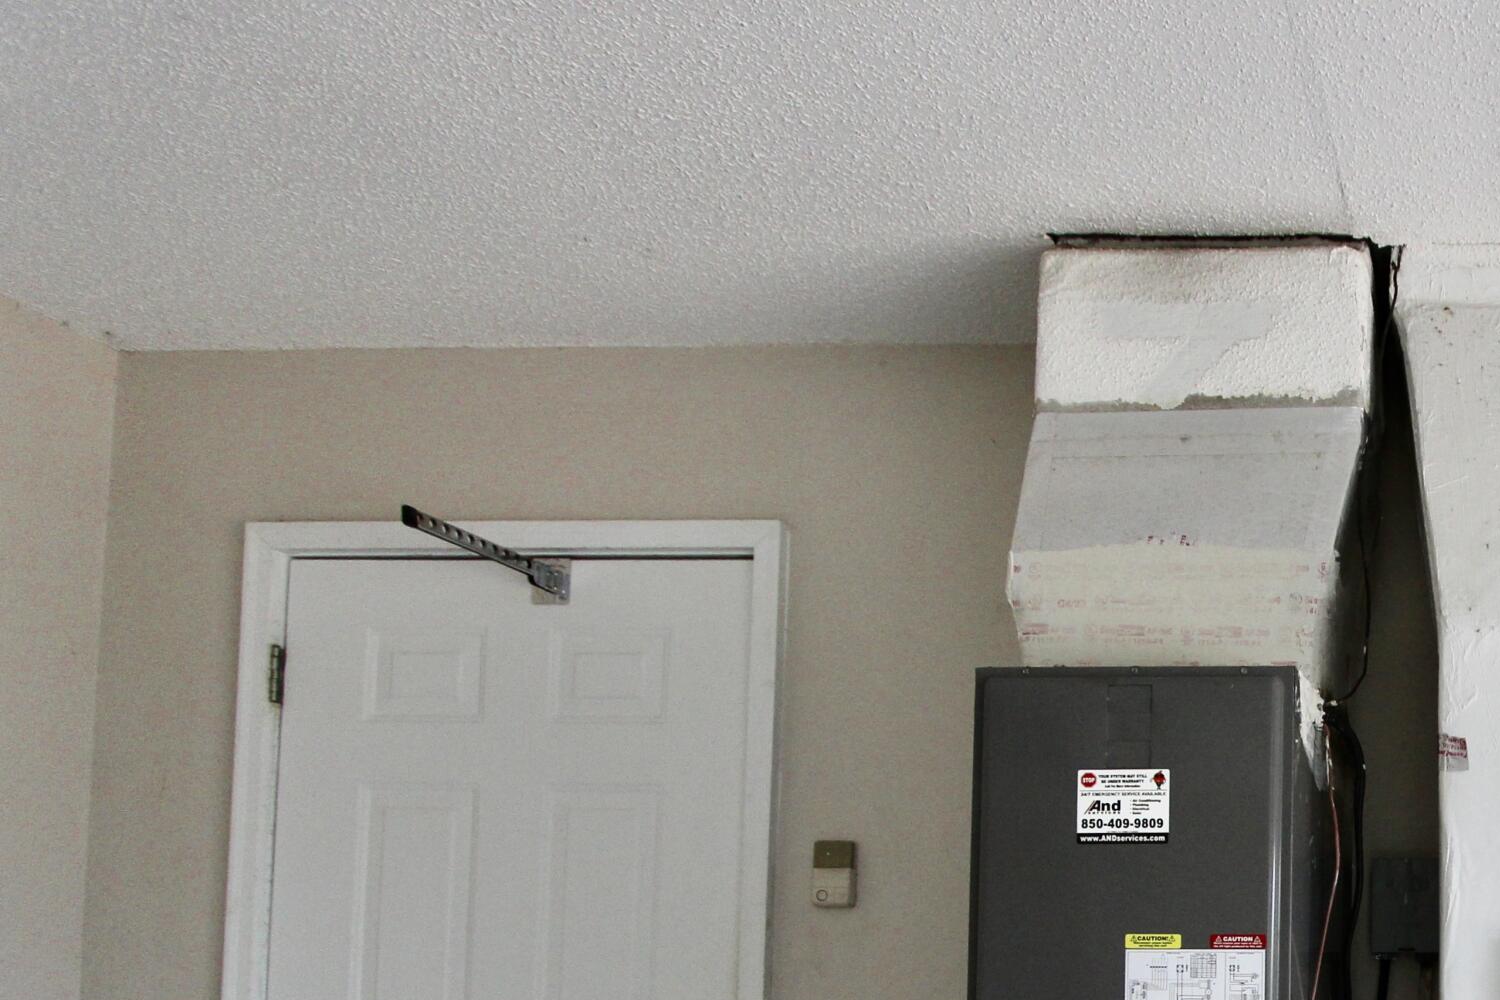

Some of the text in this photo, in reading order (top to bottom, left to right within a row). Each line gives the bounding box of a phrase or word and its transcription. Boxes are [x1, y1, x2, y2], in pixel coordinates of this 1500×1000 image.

[1089, 799, 1121, 812] And
[1081, 818, 1164, 829] 850-409-9809
[1080, 834, 1166, 842] www.ANDservices.com
